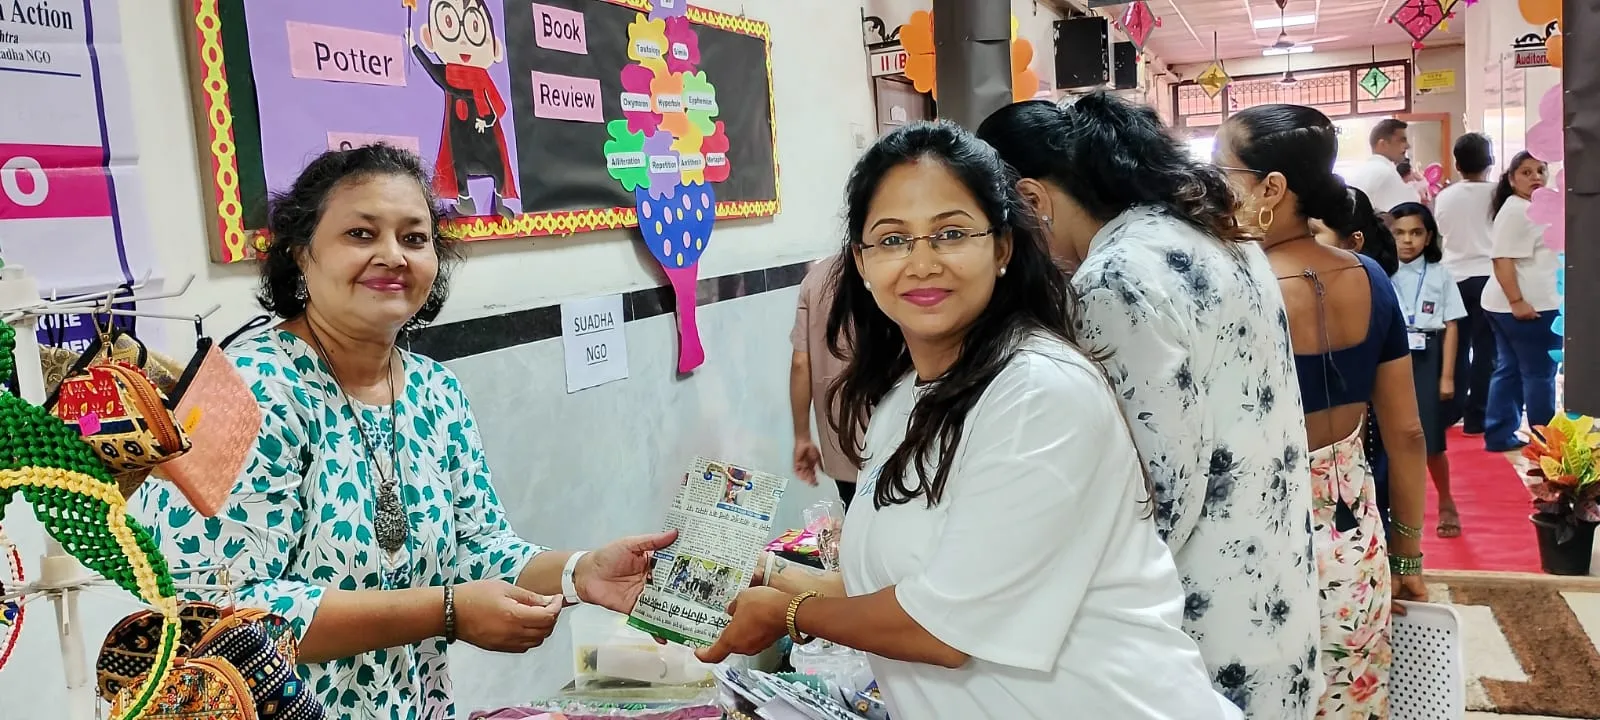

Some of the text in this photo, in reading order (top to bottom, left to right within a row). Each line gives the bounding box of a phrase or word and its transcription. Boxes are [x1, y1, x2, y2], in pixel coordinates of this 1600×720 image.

[11, 0, 73, 30] Action
[541, 11, 582, 43] Book
[0, 48, 51, 64] adha NGO
[313, 41, 393, 78] Potter
[1515, 51, 1549, 65] Auditori
[539, 83, 596, 109] Review
[574, 311, 615, 333] SUADHA
[586, 343, 607, 362] NGO
